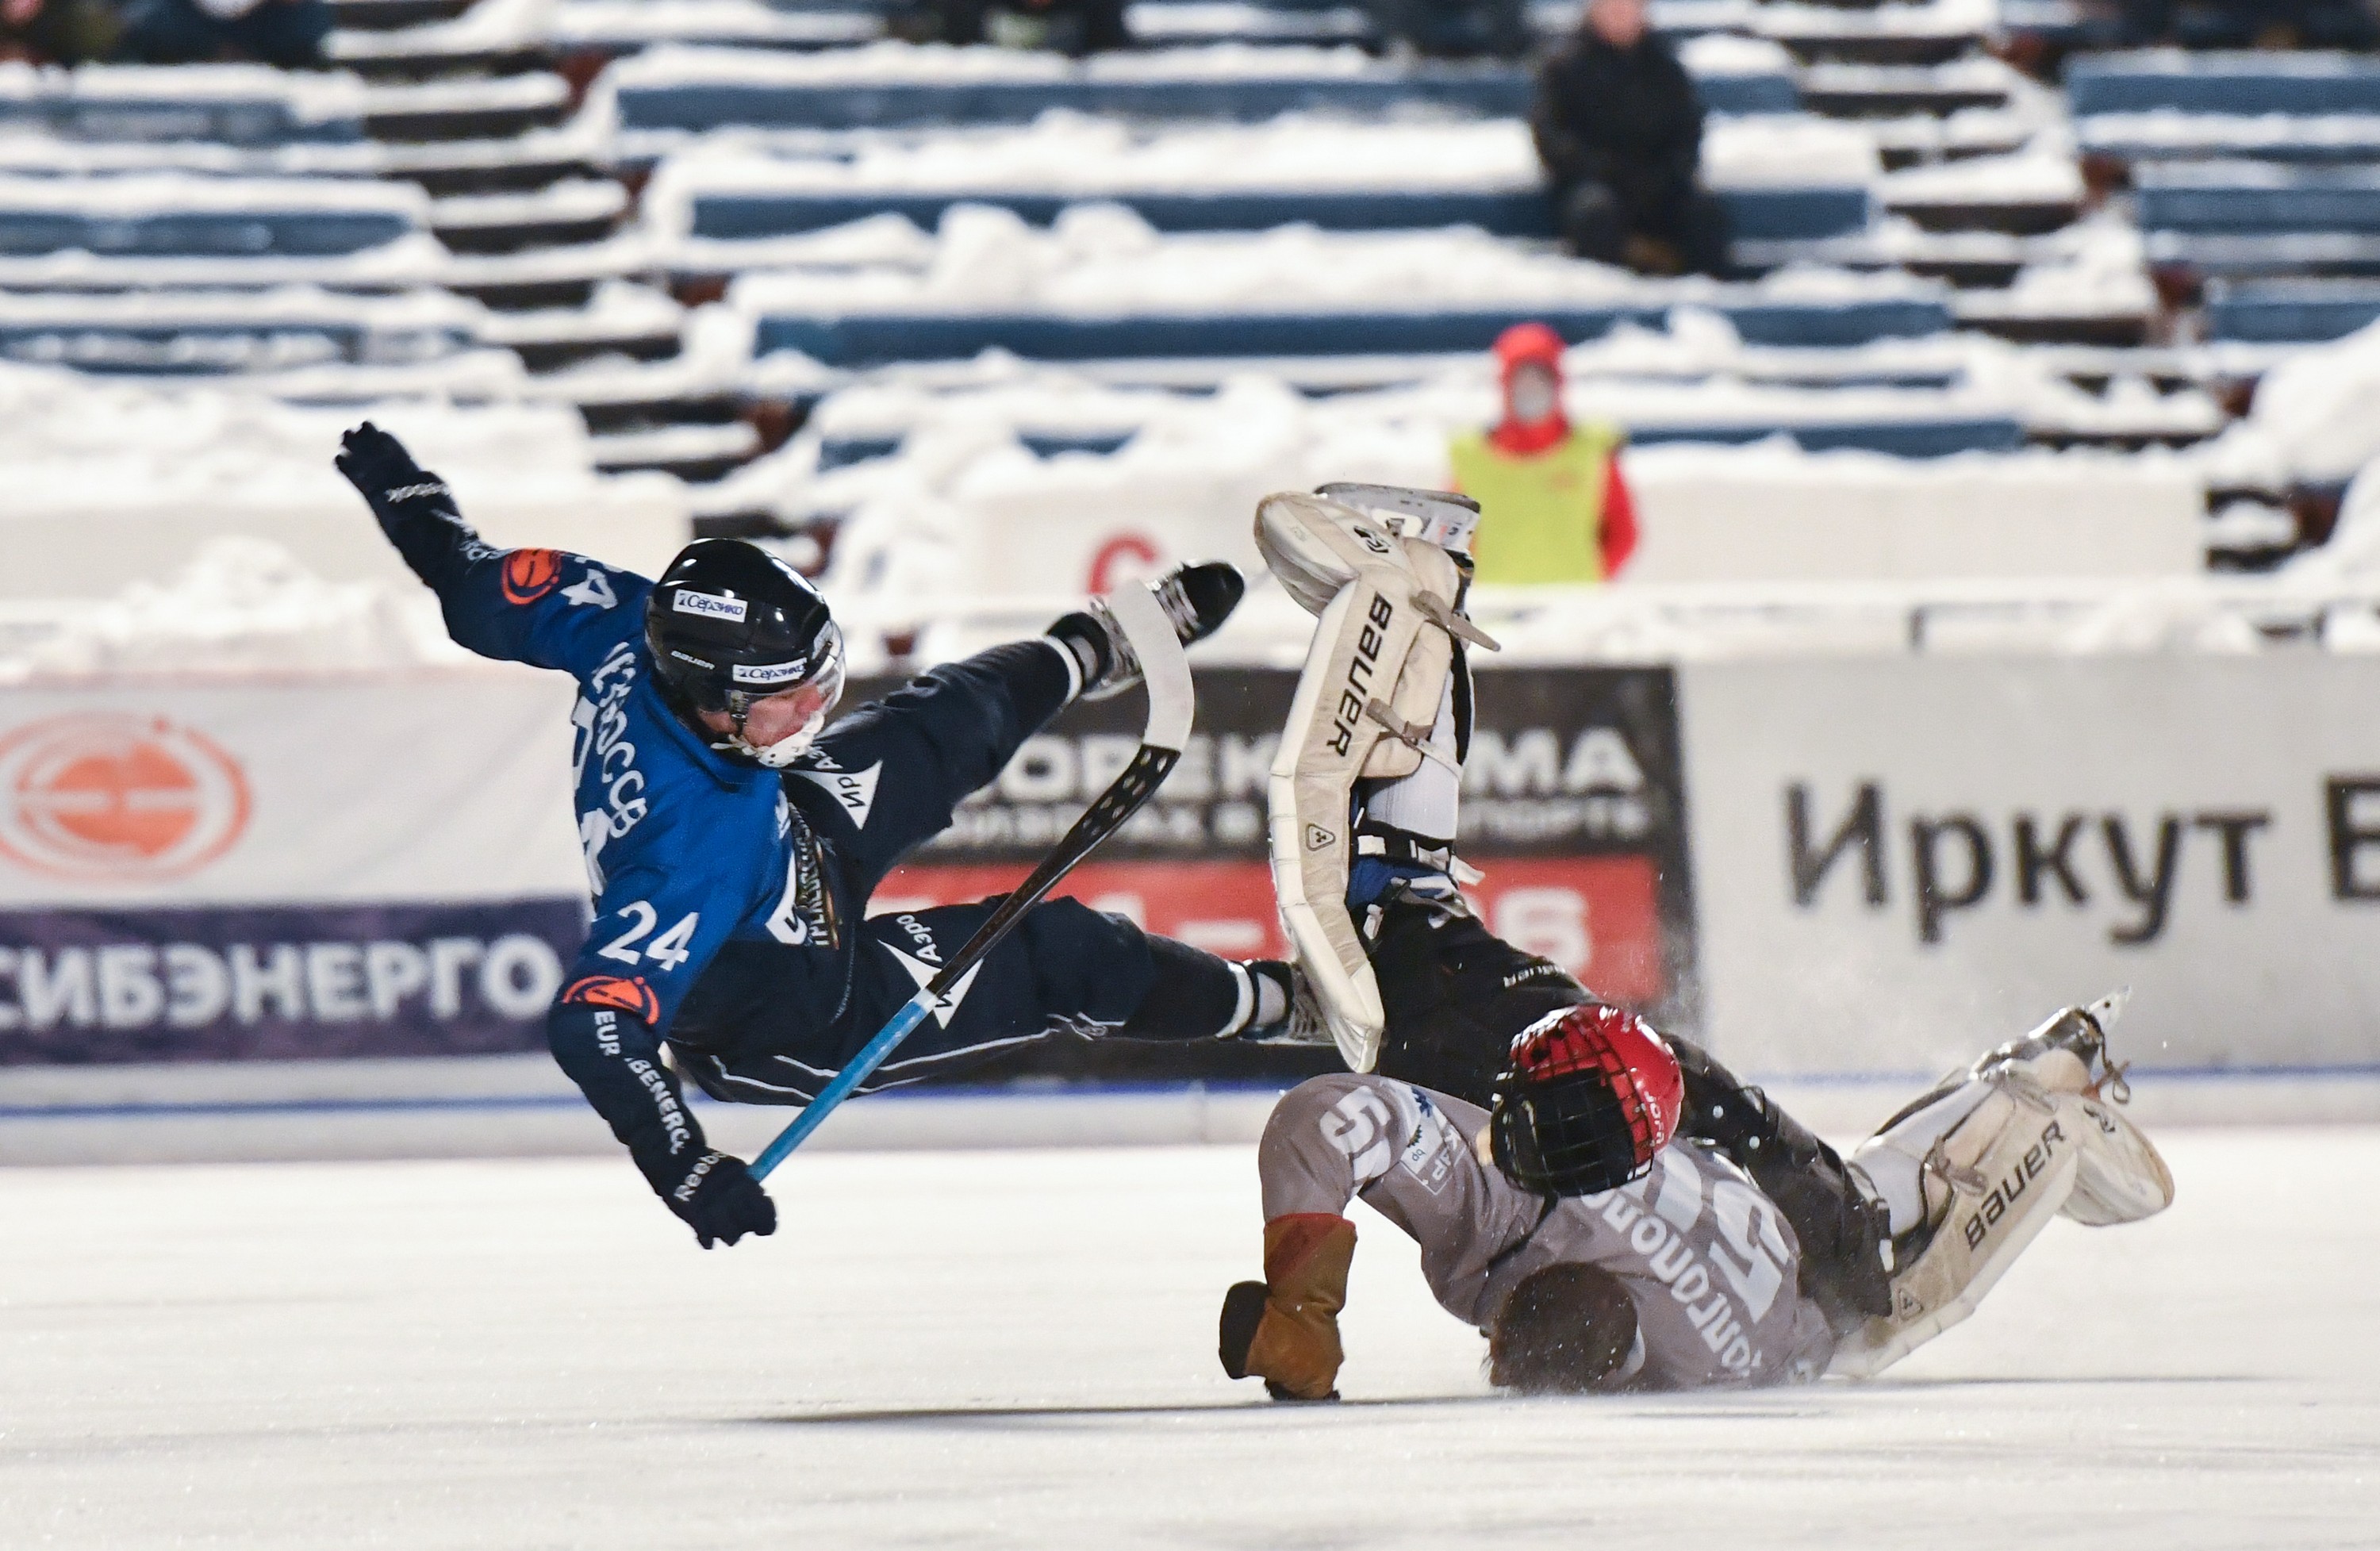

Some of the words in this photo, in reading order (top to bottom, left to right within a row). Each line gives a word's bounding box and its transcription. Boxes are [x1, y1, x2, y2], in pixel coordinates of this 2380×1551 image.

[597, 900, 699, 971] 24
[1783, 776, 2272, 946] Иркут
[1964, 1120, 2065, 1252] BAUER
[1580, 1186, 1763, 1377] ОЛГОПОЛ
